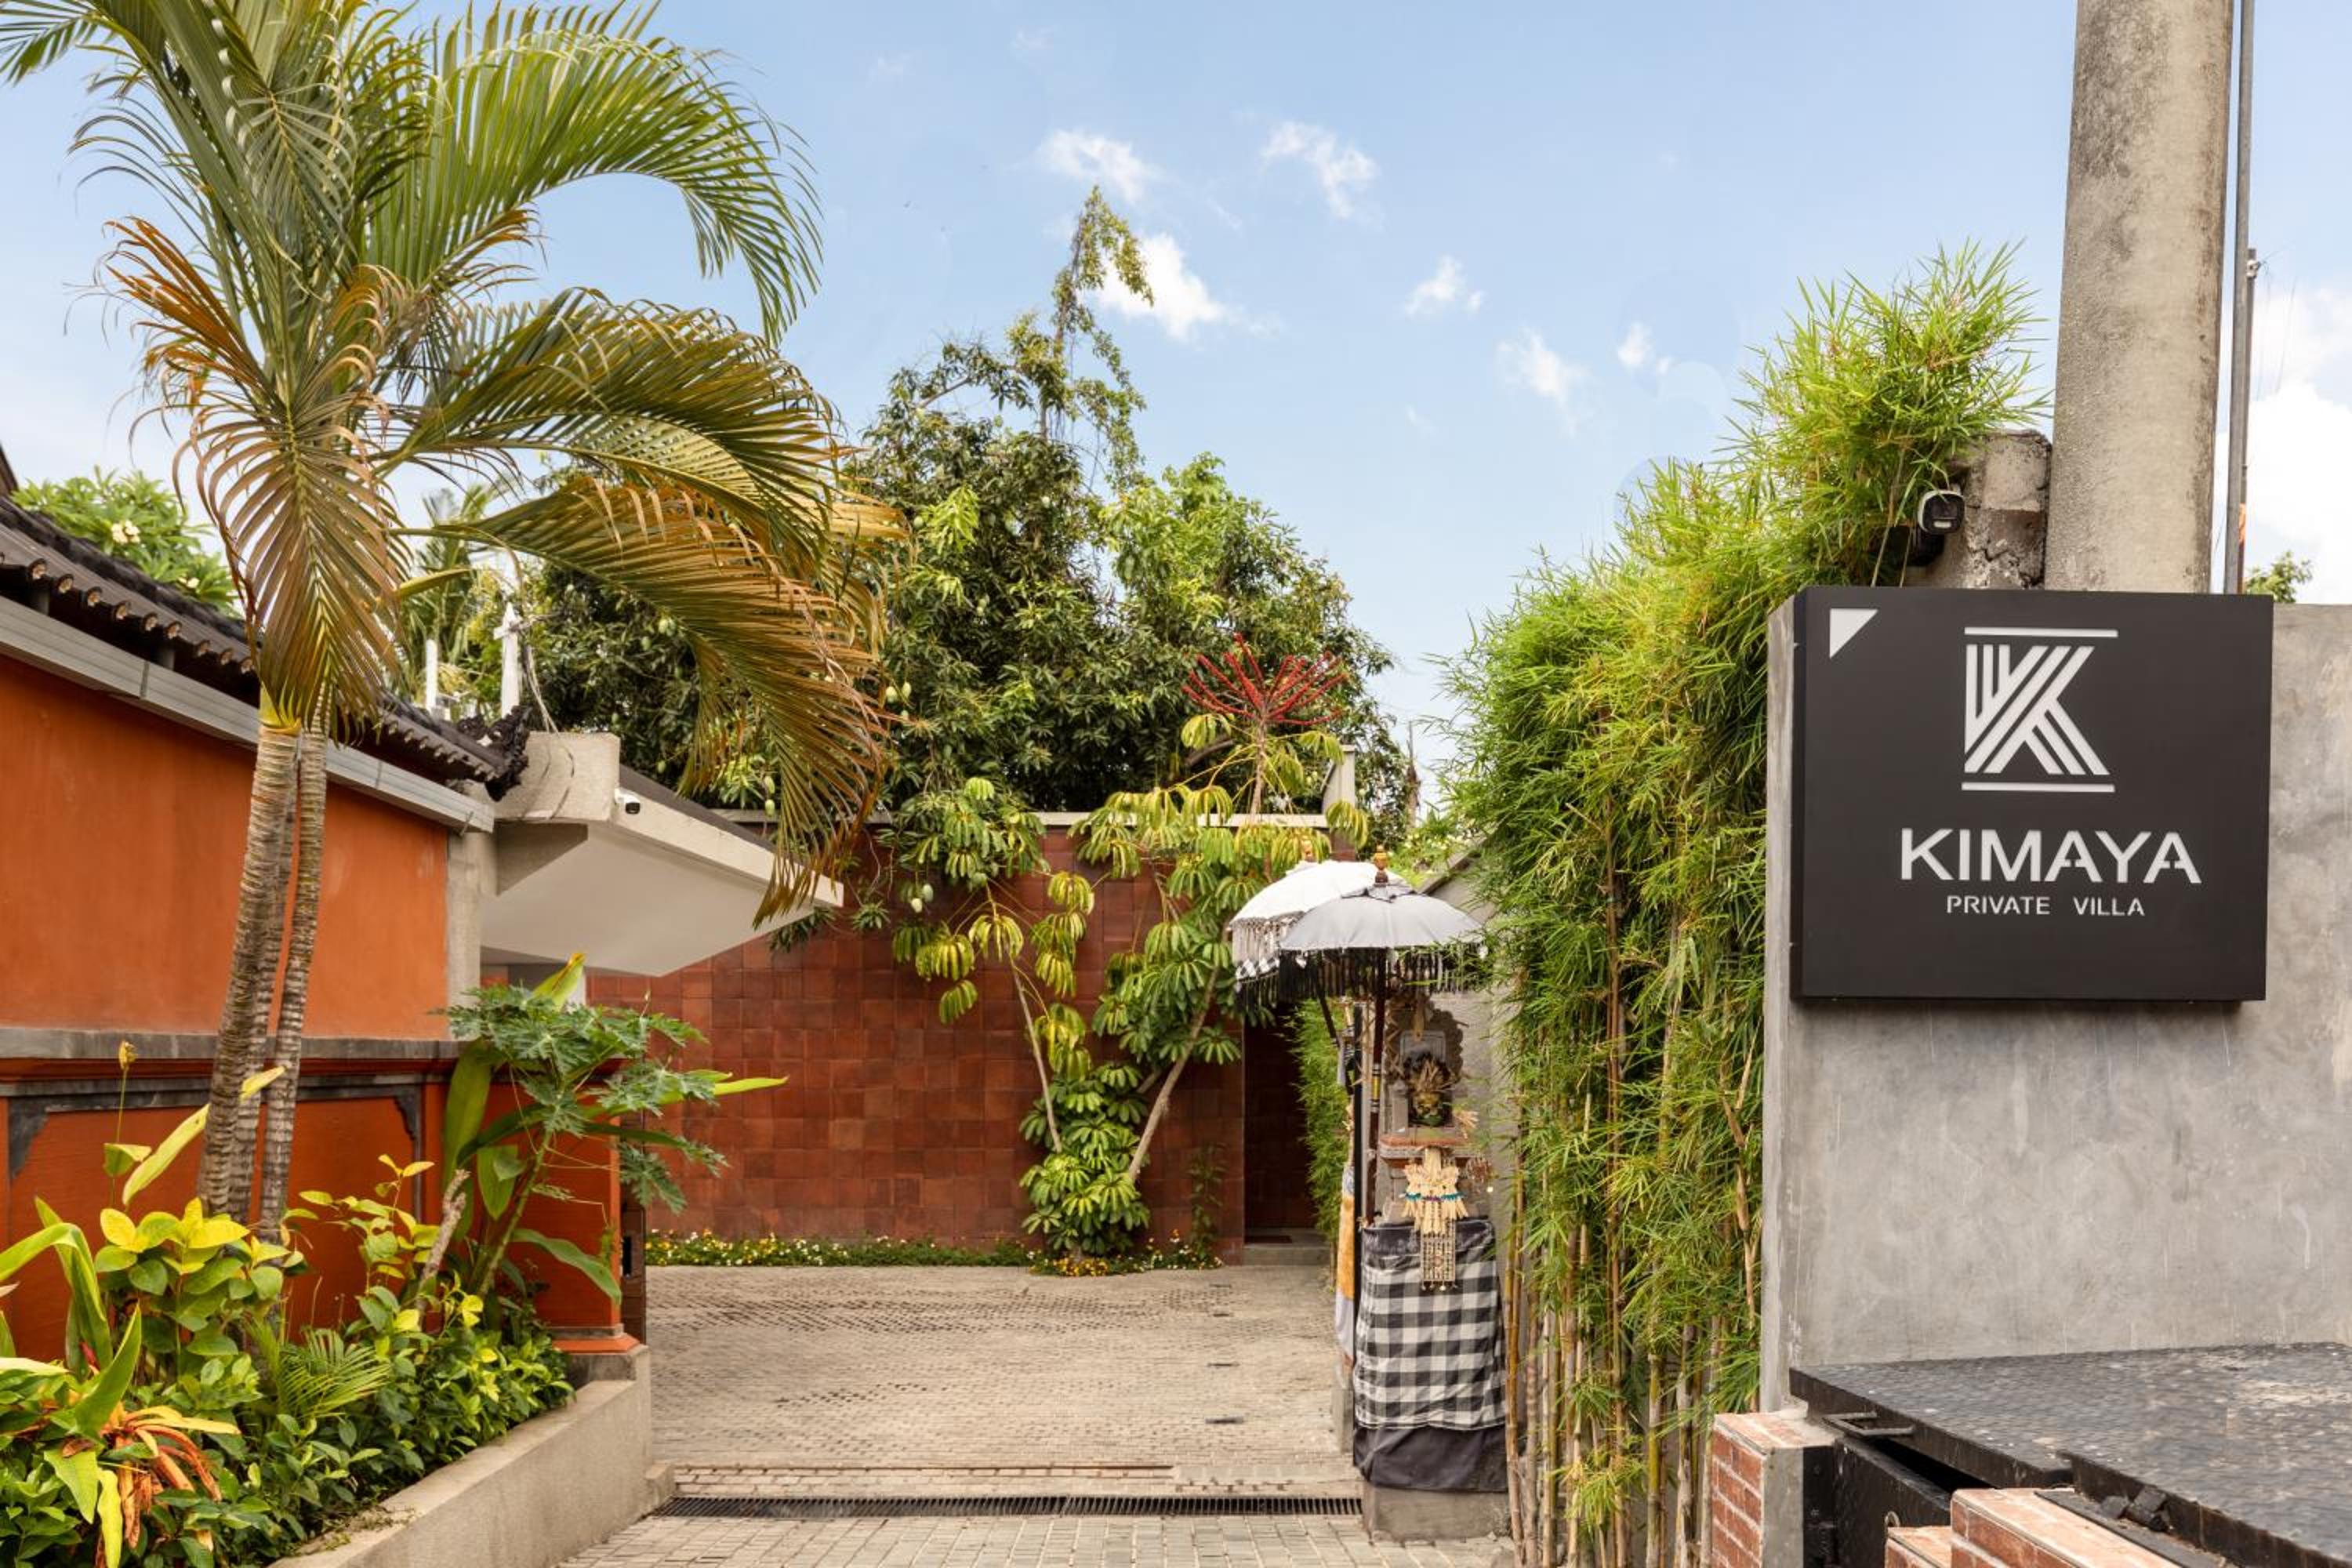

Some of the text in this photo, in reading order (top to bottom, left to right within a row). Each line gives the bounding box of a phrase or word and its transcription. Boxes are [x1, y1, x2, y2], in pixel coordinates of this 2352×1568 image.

[1900, 827, 2202, 884] KIMAYA
[1946, 895, 2146, 916] PRIVATE VILLA
